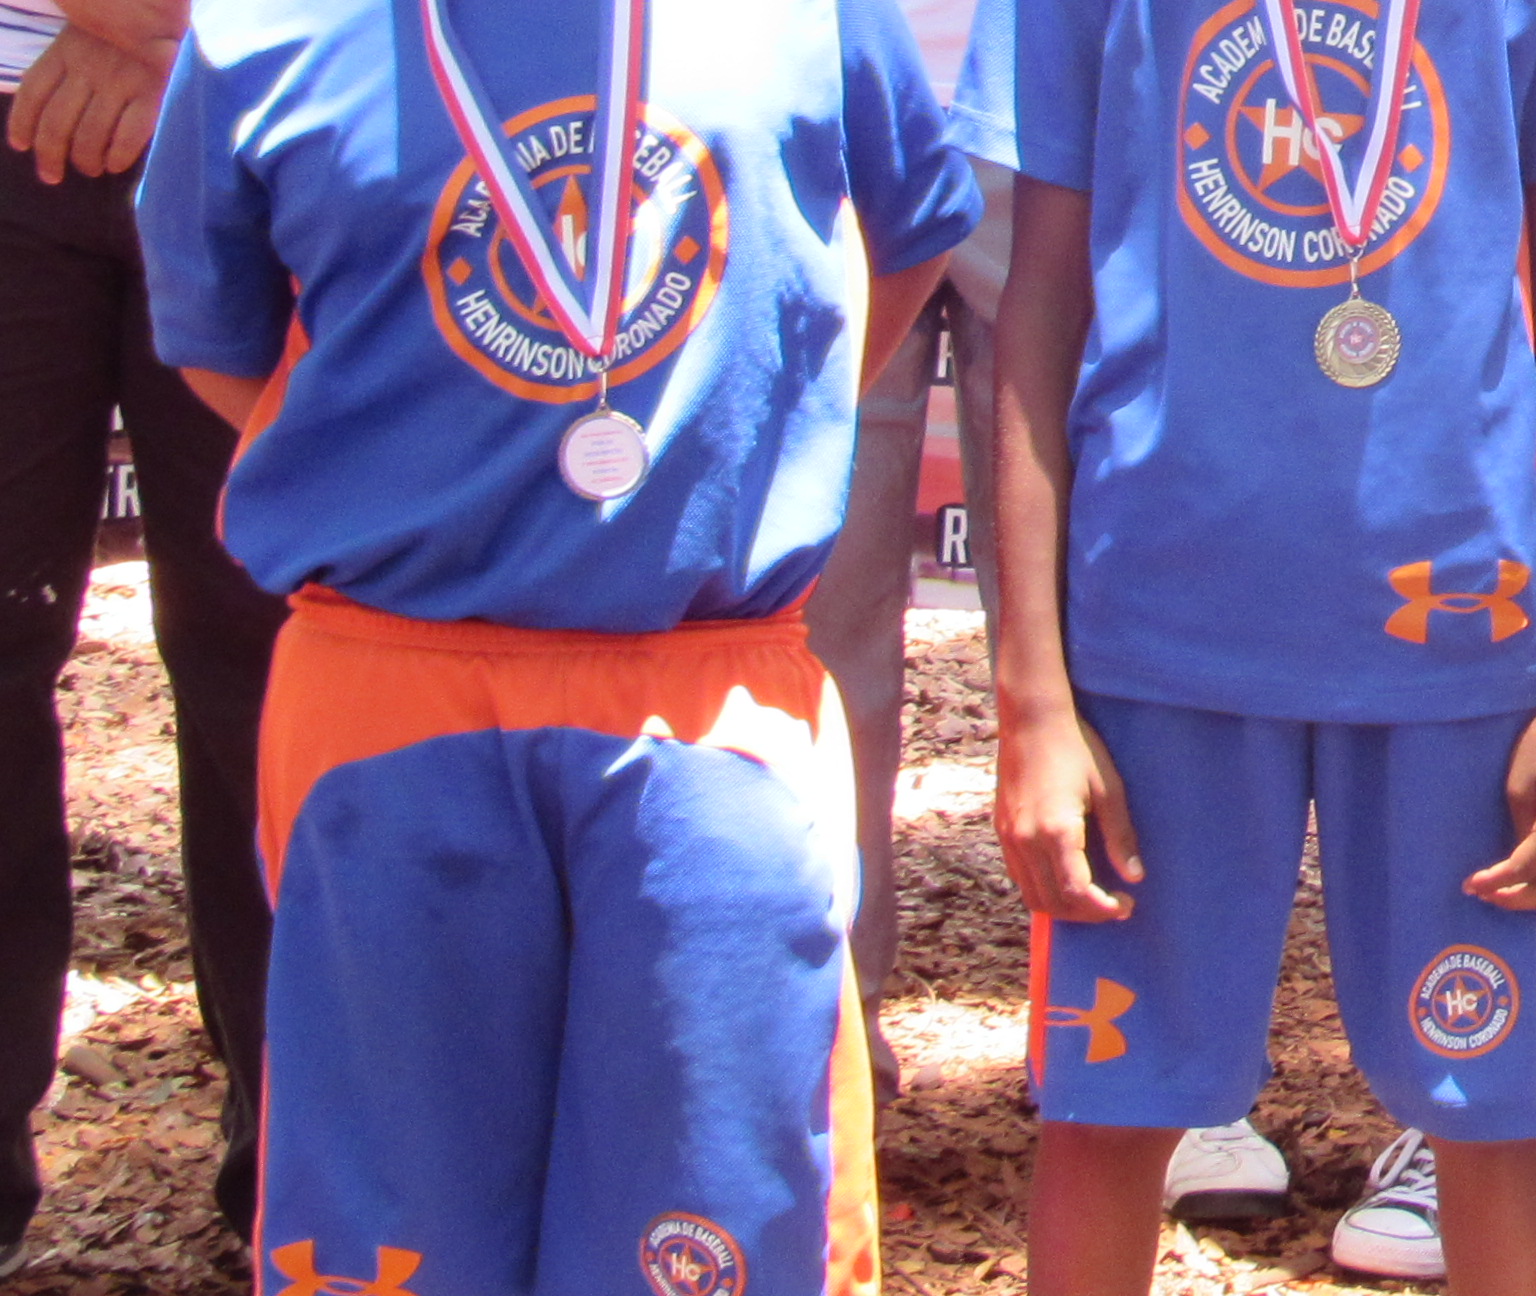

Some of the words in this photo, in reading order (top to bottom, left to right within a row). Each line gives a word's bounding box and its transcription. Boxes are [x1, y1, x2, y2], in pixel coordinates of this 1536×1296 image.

[1193, 15, 1268, 105] ACADEM
[549, 121, 584, 158] DE
[1188, 157, 1297, 263] HENRINSON
[1303, 176, 1416, 264] CORNADO
[457, 289, 585, 381] HENRINSON
